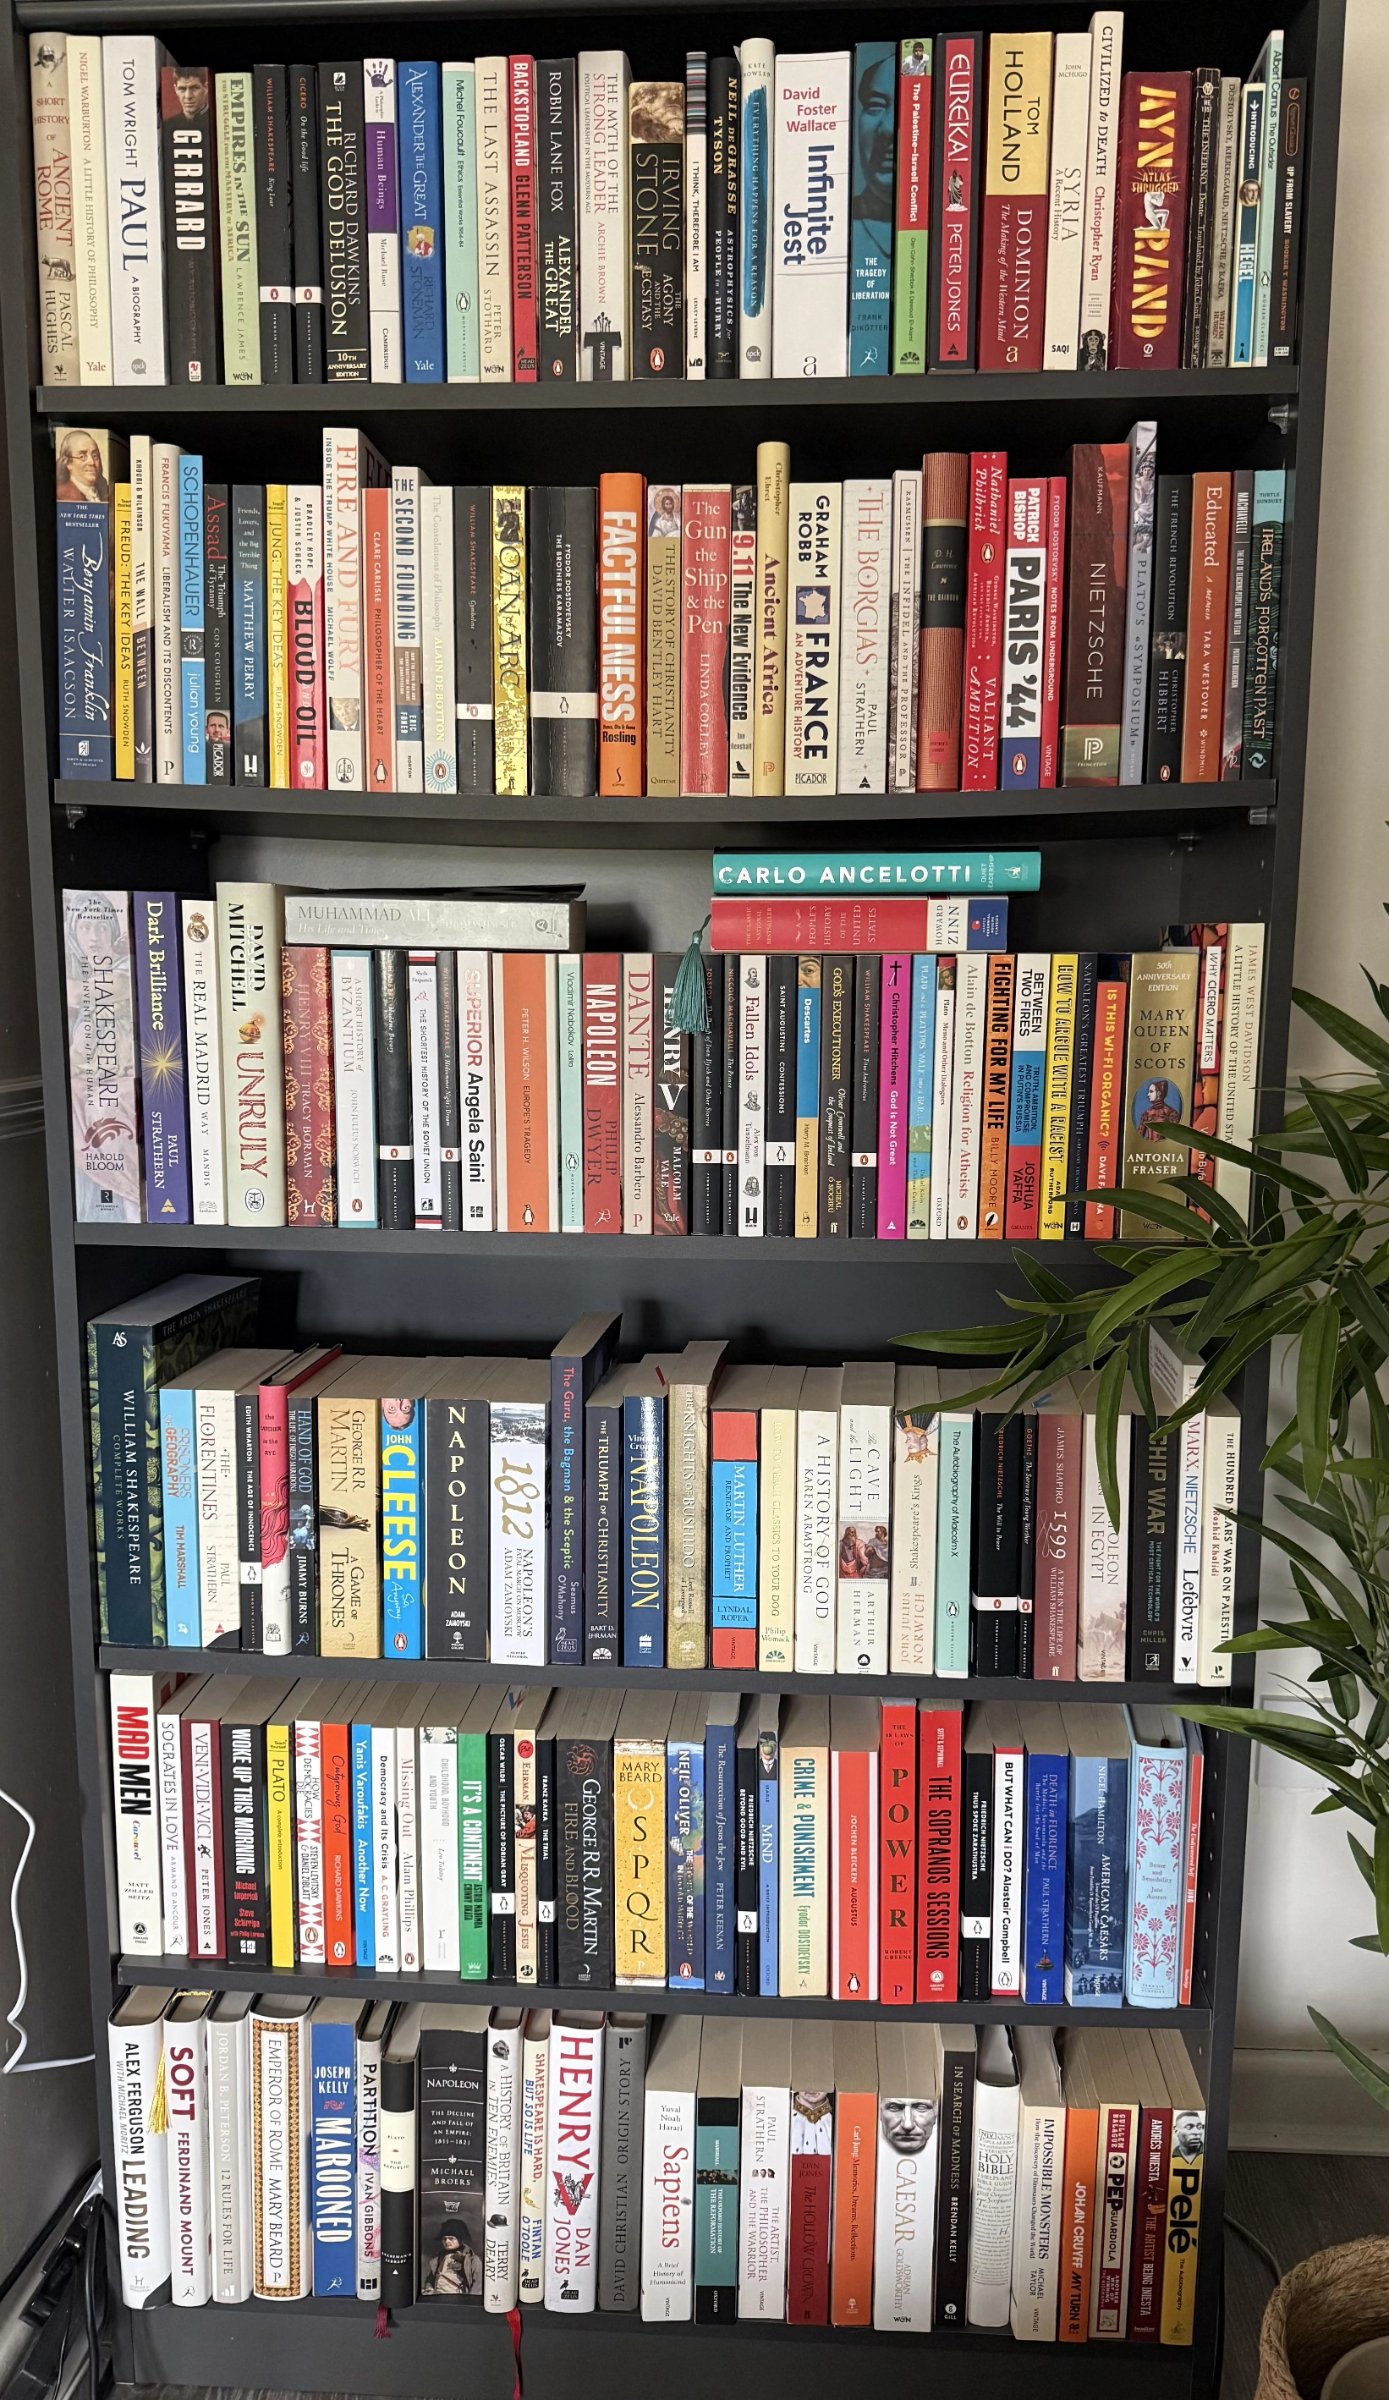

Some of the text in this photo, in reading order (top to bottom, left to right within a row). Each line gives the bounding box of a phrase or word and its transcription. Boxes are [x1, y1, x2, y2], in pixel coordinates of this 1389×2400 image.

[230, 78, 246, 173] EMPIRES
[326, 101, 343, 146] THE
[783, 89, 820, 100] David
[786, 121, 837, 132] Wallace
[797, 105, 837, 115] Foster
[948, 54, 970, 162] EUREKA!
[1001, 51, 1024, 182] HOLLAND
[1027, 97, 1040, 135] TOM
[37, 165, 53, 230] ROME
[52, 148, 72, 246] ANCIENT
[173, 130, 206, 250] GERRARD
[326, 156, 344, 209] GOD
[344, 133, 360, 305] RICHARD DAWKINS
[514, 62, 532, 299] BACKSTOPLAND GLENN PATTERSON
[807, 145, 834, 255] Infinite
[1061, 168, 1081, 241] SYRIA
[120, 179, 148, 271] PAUL
[784, 204, 806, 265] Jest
[1239, 244, 1254, 282] HEGEL
[328, 221, 347, 336] DELUSION
[1012, 209, 1032, 339] DOMINION
[1051, 345, 1069, 353] SAQI
[184, 466, 200, 616] SCHOPENHAUER
[207, 495, 227, 560] Assad
[798, 512, 811, 562] ROBB
[815, 495, 829, 578] GRAHAM
[1204, 486, 1222, 567] Educated
[395, 498, 417, 640] SECOND FOUNDING
[63, 548, 76, 718] WALTER ISAACSON
[244, 580, 254, 699] MATTHEW PERRY
[602, 511, 637, 721] FACTFULNESS
[732, 535, 754, 720] 9.11 The New Evidence
[762, 554, 780, 716] Ancient Africa
[1006, 557, 1041, 665] PARIS
[1086, 563, 1106, 698] NIETZSCHE
[804, 633, 828, 759] FRANCE
[603, 731, 637, 745] Rosling
[718, 865, 971, 884] CARLO ANCELOTTI
[228, 903, 245, 1012] MITCHELL
[948, 905, 960, 945] ZINN
[147, 901, 166, 1031] Dark Brilliance
[991, 963, 1010, 1033] FIGHTING
[1031, 973, 1044, 1032] BETWEEN
[1206, 980, 1216, 1015] CICERO
[93, 955, 118, 1107] SHAKESPEARE
[586, 984, 616, 1086] NAPOLEON
[628, 971, 650, 1080] DANTE
[745, 995, 760, 1081] Fallen Idols
[803, 999, 812, 1043] Descartes
[831, 1000, 843, 1080] EXECUTIONER
[1135, 1026, 1189, 1036] QUEEN
[960, 1071, 974, 1124] Religion
[1134, 1060, 1186, 1069] SCOTS
[237, 1052, 268, 1178] UNRULY
[302, 1082, 313, 1178] TRACY BORMAN
[465, 1072, 484, 1182] Angela Saini
[1048, 1116, 1066, 1162] RACIST
[87, 1162, 124, 1171] BLOOM
[1012, 1168, 1024, 1204] YAFFA
[1023, 1161, 1035, 1210] JOSHUA
[123, 1390, 141, 1584] WILLIAM SHAKESPEARE
[165, 1427, 178, 1497] GEOGRAPHY
[331, 1410, 347, 1492] MARTIN
[562, 1449, 574, 1491] Bagman
[848, 1448, 862, 1512] LIGHT
[867, 1448, 880, 1500] CAVE
[1184, 1421, 1200, 1554] MARX, NIETZSCHE
[382, 1445, 416, 1580] CLEESE
[494, 1457, 540, 1539] 1812
[733, 1465, 746, 1592] MARTIN LUTHER
[815, 1456, 830, 1537] HISTORY
[1049, 1511, 1067, 1559] 1599
[1147, 1487, 1164, 1534] WAR
[176, 1543, 186, 1588] MARSHALL
[297, 1555, 308, 1624] JIMMY BURNS
[331, 1548, 349, 1627] THRONES
[598, 1518, 609, 1617] CHRISTIANITY
[803, 1514, 813, 1593] ARMSTRONG
[504, 1581, 513, 1637] ZAMOYSKI
[1181, 1569, 1200, 1641] Lefebvre
[118, 1706, 151, 1815] MAD MEN
[162, 1722, 177, 1794] SOCRATES
[273, 1760, 285, 1802] PLATO
[304, 1759, 313, 1818] DEMOCRACIES
[357, 1741, 368, 1829] Yanis Varoufakis
[378, 1756, 388, 1810] Democracy
[619, 1773, 662, 1782] BEARD
[794, 1758, 815, 1798] CRIME
[235, 1817, 254, 1874] MORNING
[463, 1820, 484, 1880] CONTINENT
[679, 1787, 690, 1835] OLIVER
[793, 1815, 815, 1897] PUNISHMENT
[926, 1810, 952, 1958] SOPRANOS SESSIONS
[566, 1874, 579, 1930] BLOOD
[1000, 1875, 1012, 1963] Alastair Campbell
[1099, 1854, 1111, 1960] AMERICAN CAESARS
[126, 2043, 144, 2154] ALEX FERGUSON
[170, 2047, 195, 2120] SOFT
[268, 2040, 282, 2106] EMPEROR
[363, 2064, 377, 2155] PARTITION
[558, 2036, 593, 2170] HENRY
[178, 2132, 194, 2275] FERDINAND MOUNT
[315, 2117, 352, 2243] MAROONED
[655, 2145, 688, 2248] Sapiens
[894, 2158, 917, 2245] CAESAR
[1038, 2119, 1055, 2259] IMPOSSIBLE MONSTERS
[1108, 2174, 1125, 2211] PEP
[1149, 2152, 1161, 2182] INIESTA
[122, 2160, 150, 2258] LEADING
[364, 2205, 374, 2257] GIBBONS
[531, 2220, 542, 2259] FINTAN
[553, 2218, 571, 2274] JONES
[575, 2228, 591, 2267] DAN
[758, 2206, 769, 2282] PHILOSOPHER
[949, 2197, 958, 2262] BRENDAN KELLY
[1072, 2182, 1086, 2268] JOHAN CRUYFF
[1168, 2169, 1199, 2254] Pelé
